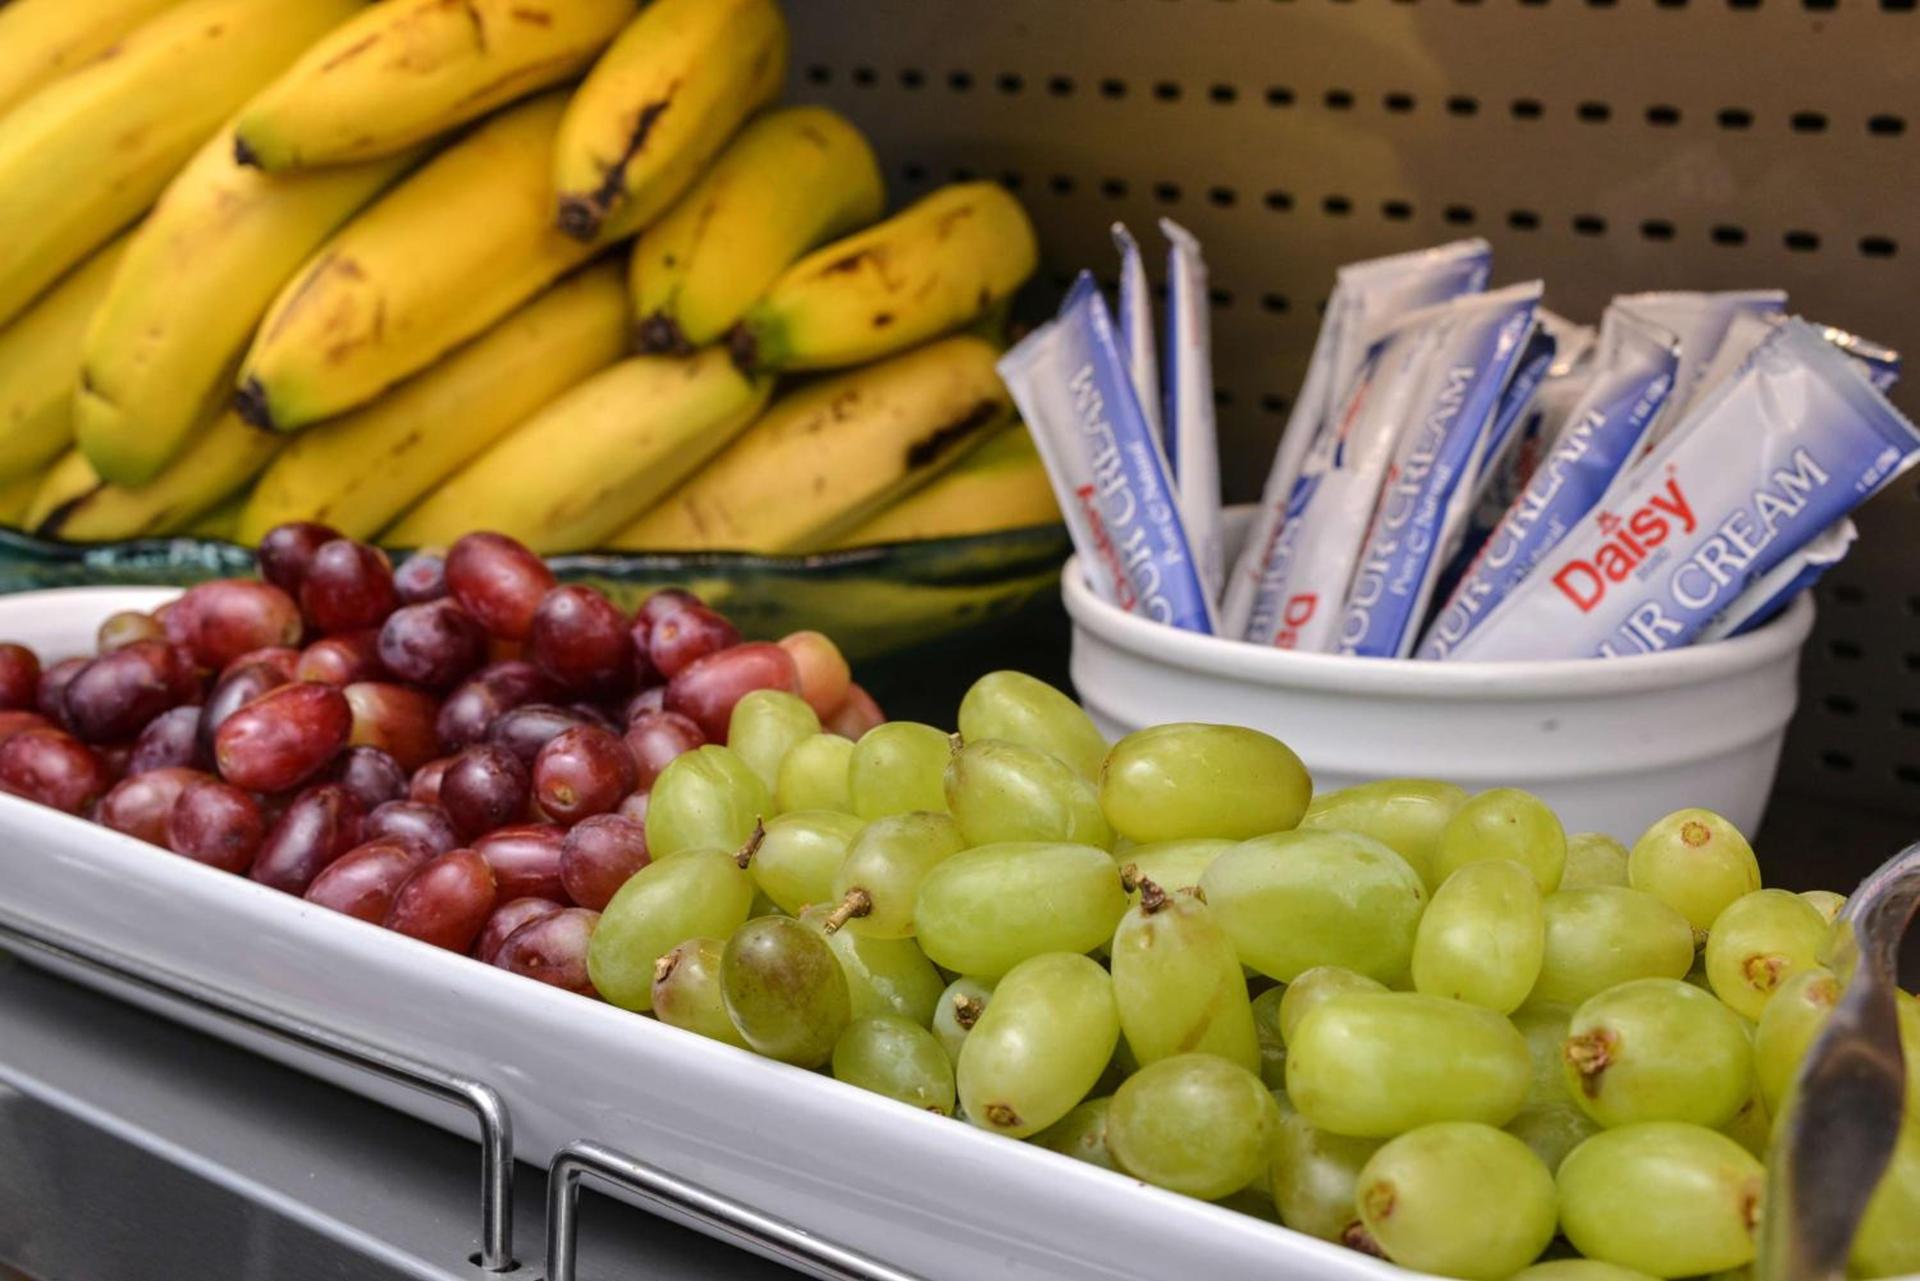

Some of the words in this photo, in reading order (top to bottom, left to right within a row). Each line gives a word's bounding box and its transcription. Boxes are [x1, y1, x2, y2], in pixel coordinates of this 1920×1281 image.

[1069, 362, 1137, 527] CREAM
[1339, 540, 1397, 656] OUR
[1386, 366, 1475, 529] CREAM
[1122, 526, 1174, 627] OUR
[1552, 478, 1697, 613] Daisy
[1599, 601, 1684, 659] UR
[1671, 448, 1830, 611] CREAM
